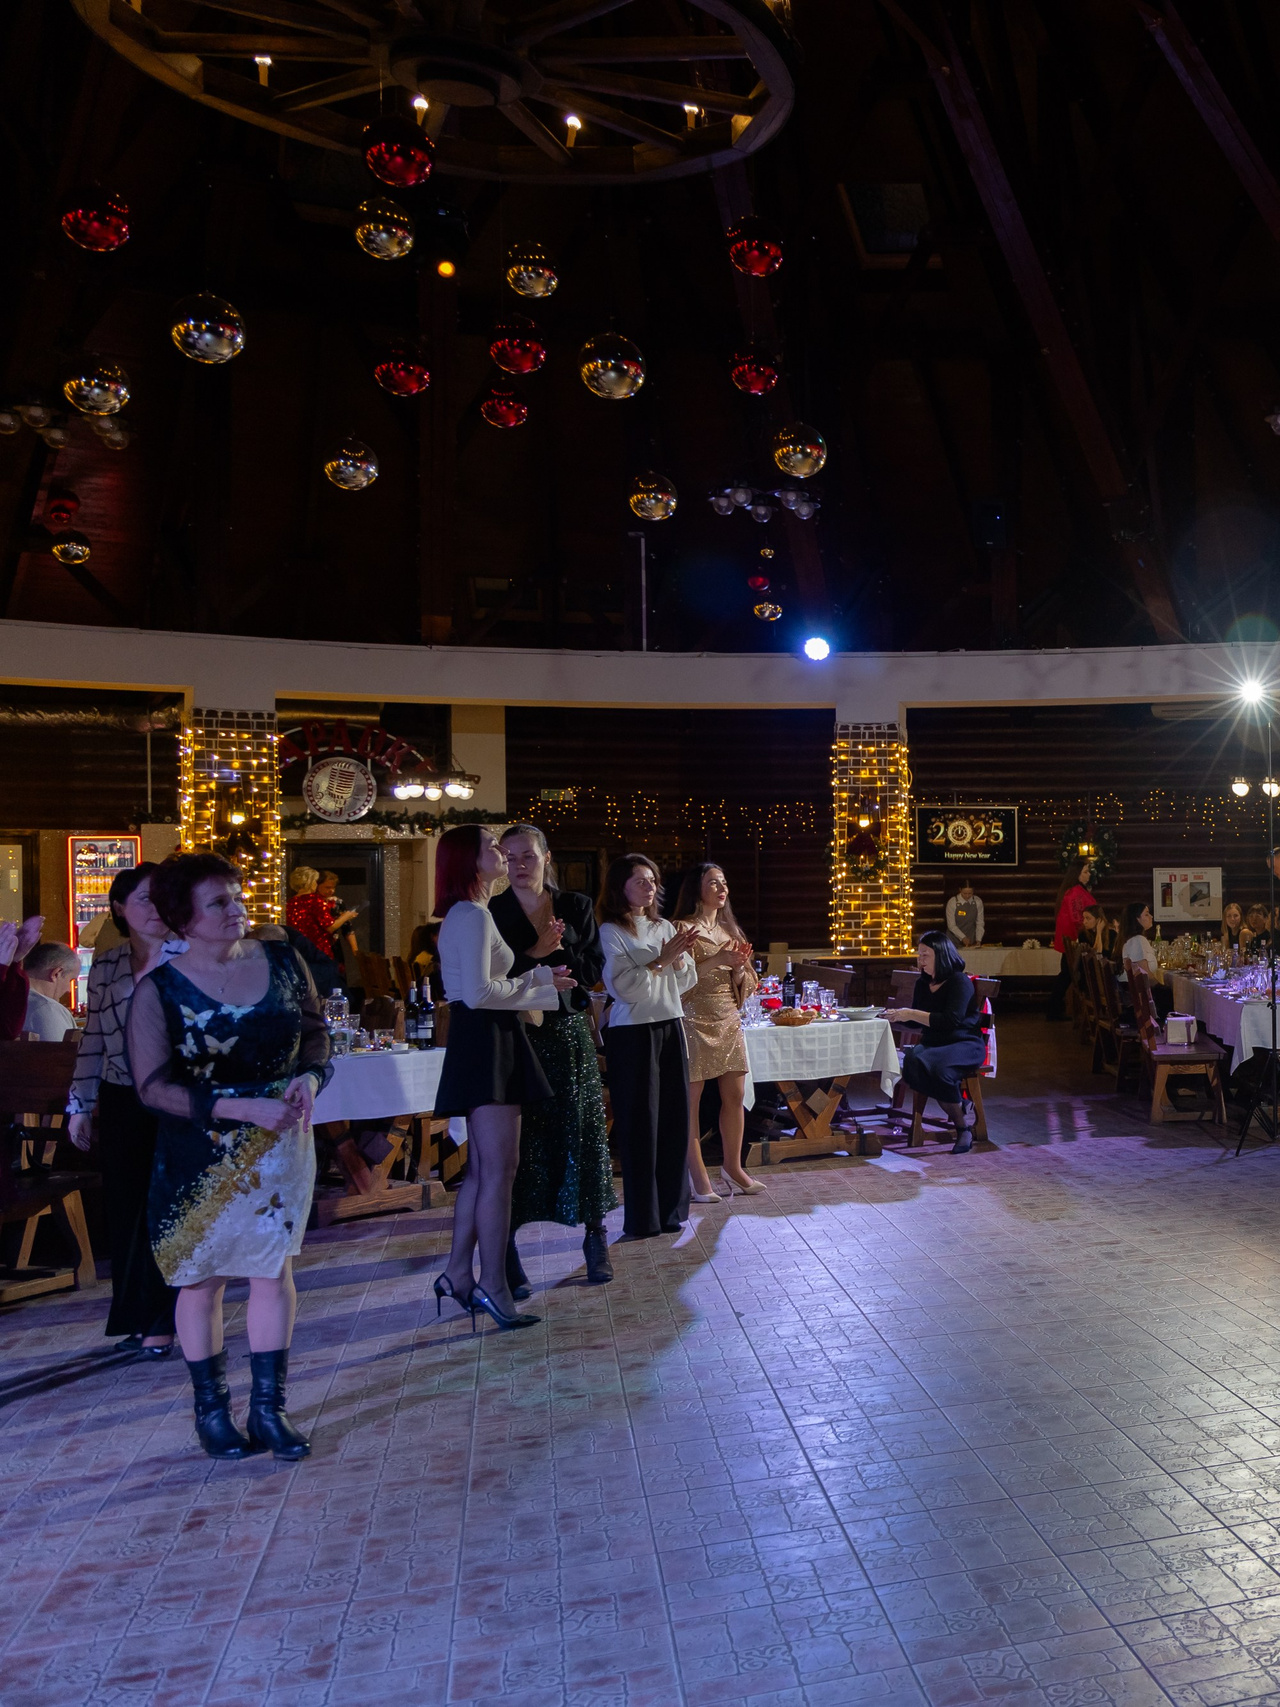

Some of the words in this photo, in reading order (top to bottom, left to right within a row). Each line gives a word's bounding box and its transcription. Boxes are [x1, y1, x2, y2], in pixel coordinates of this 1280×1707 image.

[279, 719, 438, 774] АРАОК
[932, 820, 1004, 845] 2025
[944, 852, 964, 860] Happy
